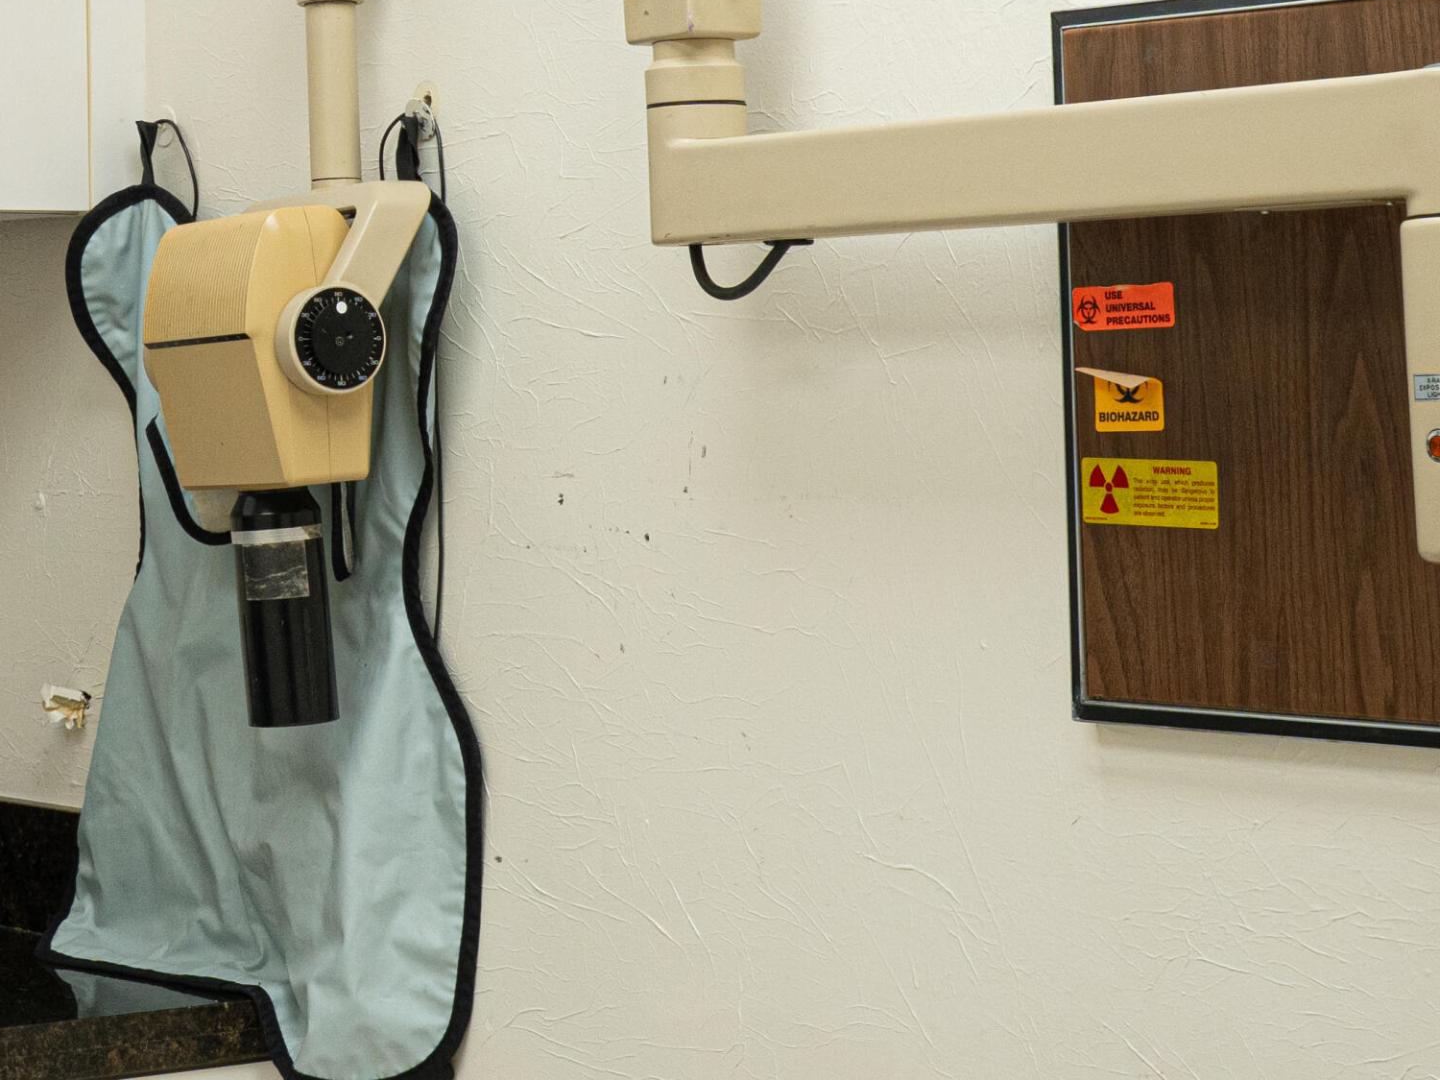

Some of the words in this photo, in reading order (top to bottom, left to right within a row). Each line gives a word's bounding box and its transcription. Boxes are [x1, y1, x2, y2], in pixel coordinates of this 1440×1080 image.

[1104, 290, 1123, 300] USE
[1105, 301, 1156, 313] UNIVERSAL
[1106, 313, 1171, 325] PRECAUTIONS
[1419, 383, 1440, 391] EXPOS
[1098, 410, 1160, 423] BIOHAZARD
[1152, 466, 1192, 476] WARNING
